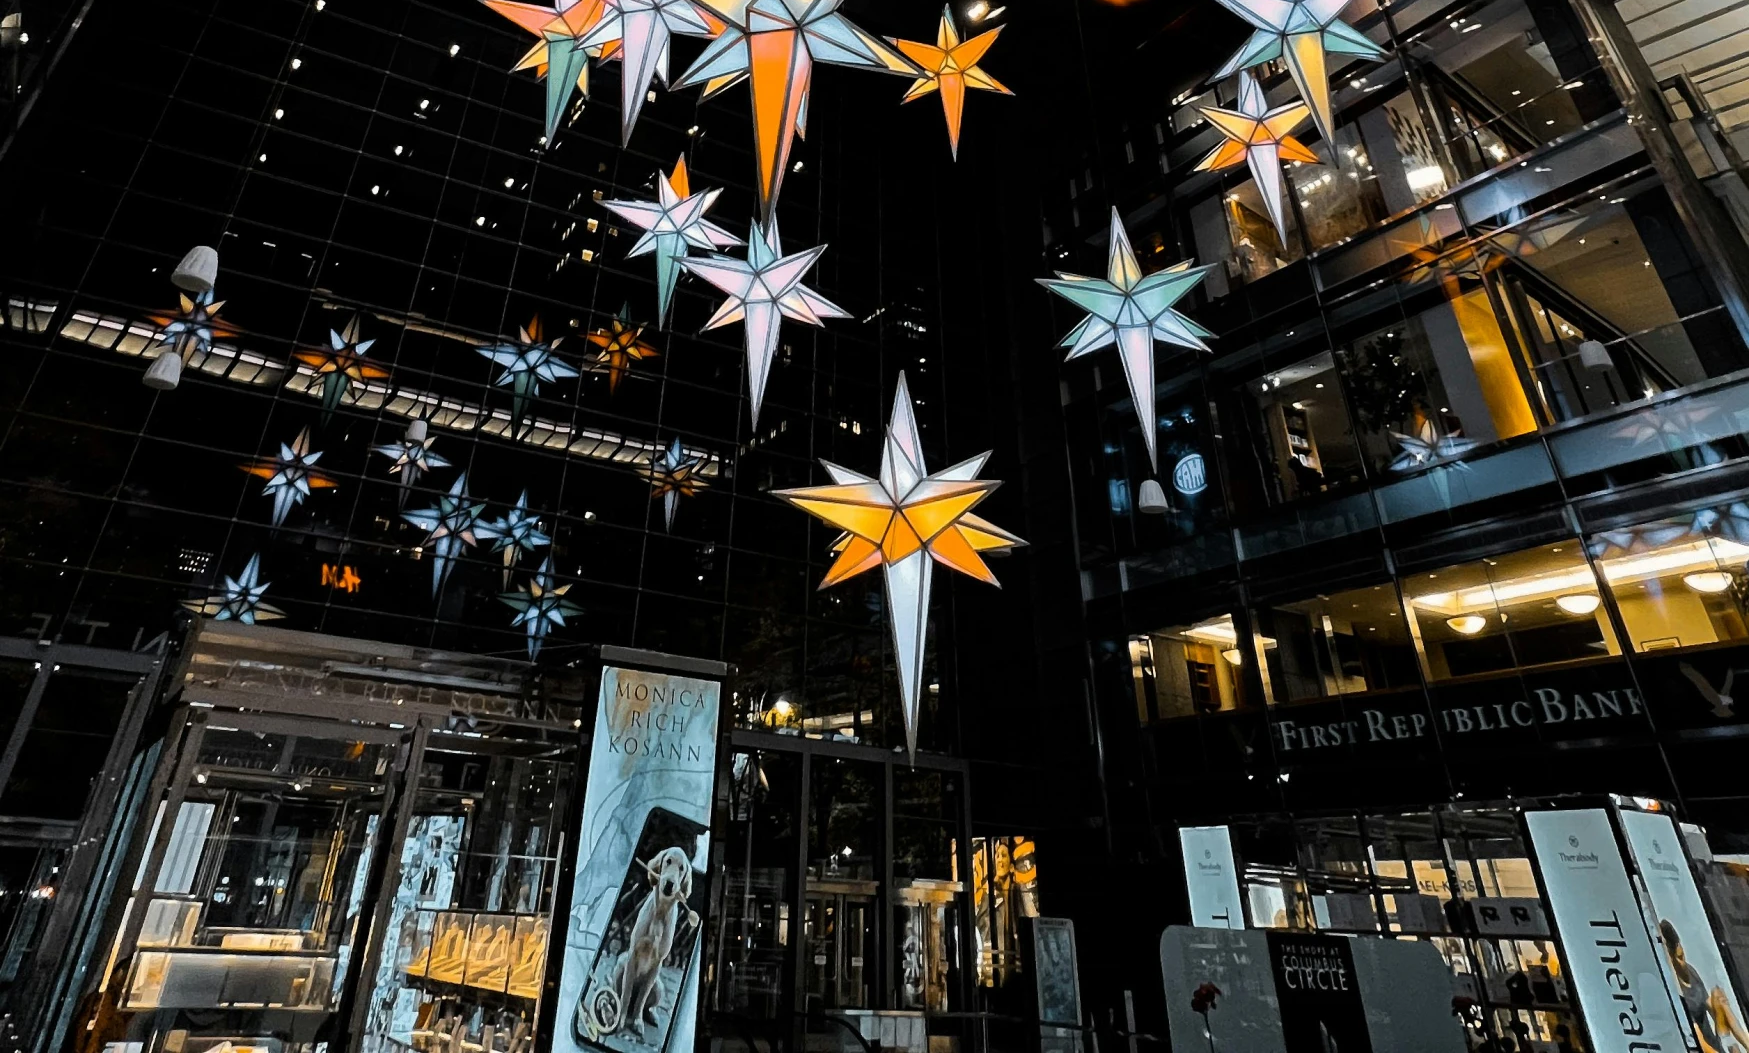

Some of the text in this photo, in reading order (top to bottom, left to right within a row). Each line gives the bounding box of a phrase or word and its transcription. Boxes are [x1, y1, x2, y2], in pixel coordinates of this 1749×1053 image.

[615, 682, 705, 709] MONICA
[630, 710, 685, 733] RICH
[1278, 719, 1359, 751] FIRST
[608, 736, 702, 762] KOSANN
[1441, 879, 1477, 893] KRS
[1281, 954, 1346, 971] COLUMBUS
[1284, 966, 1349, 991] CIRCLE
